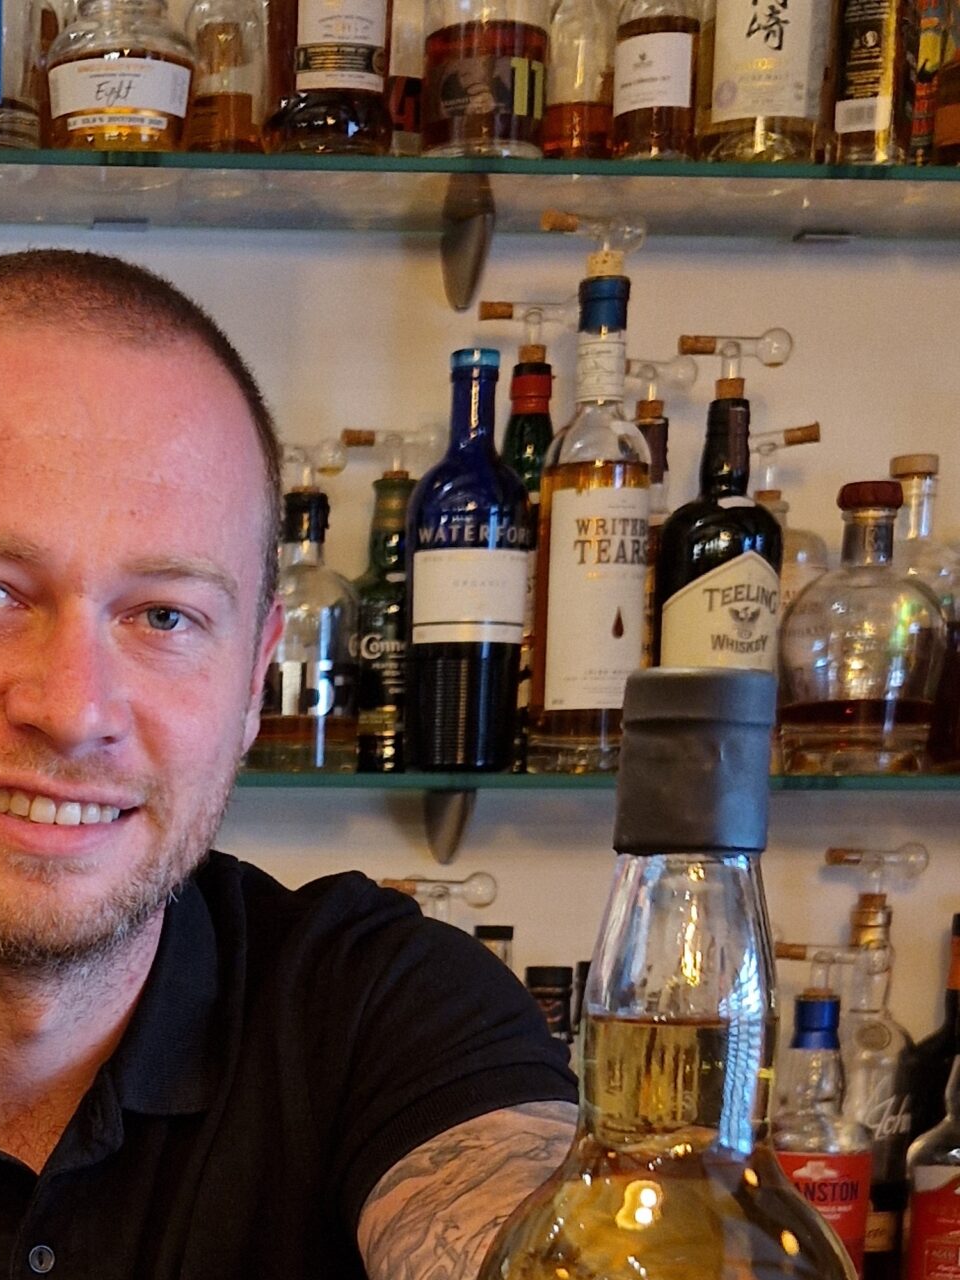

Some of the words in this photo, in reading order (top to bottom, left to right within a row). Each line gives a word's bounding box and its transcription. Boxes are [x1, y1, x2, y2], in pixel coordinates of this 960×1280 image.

[745, 0, 790, 51] 崎
[418, 524, 531, 544] WATERFOR
[575, 516, 648, 537] WRITER
